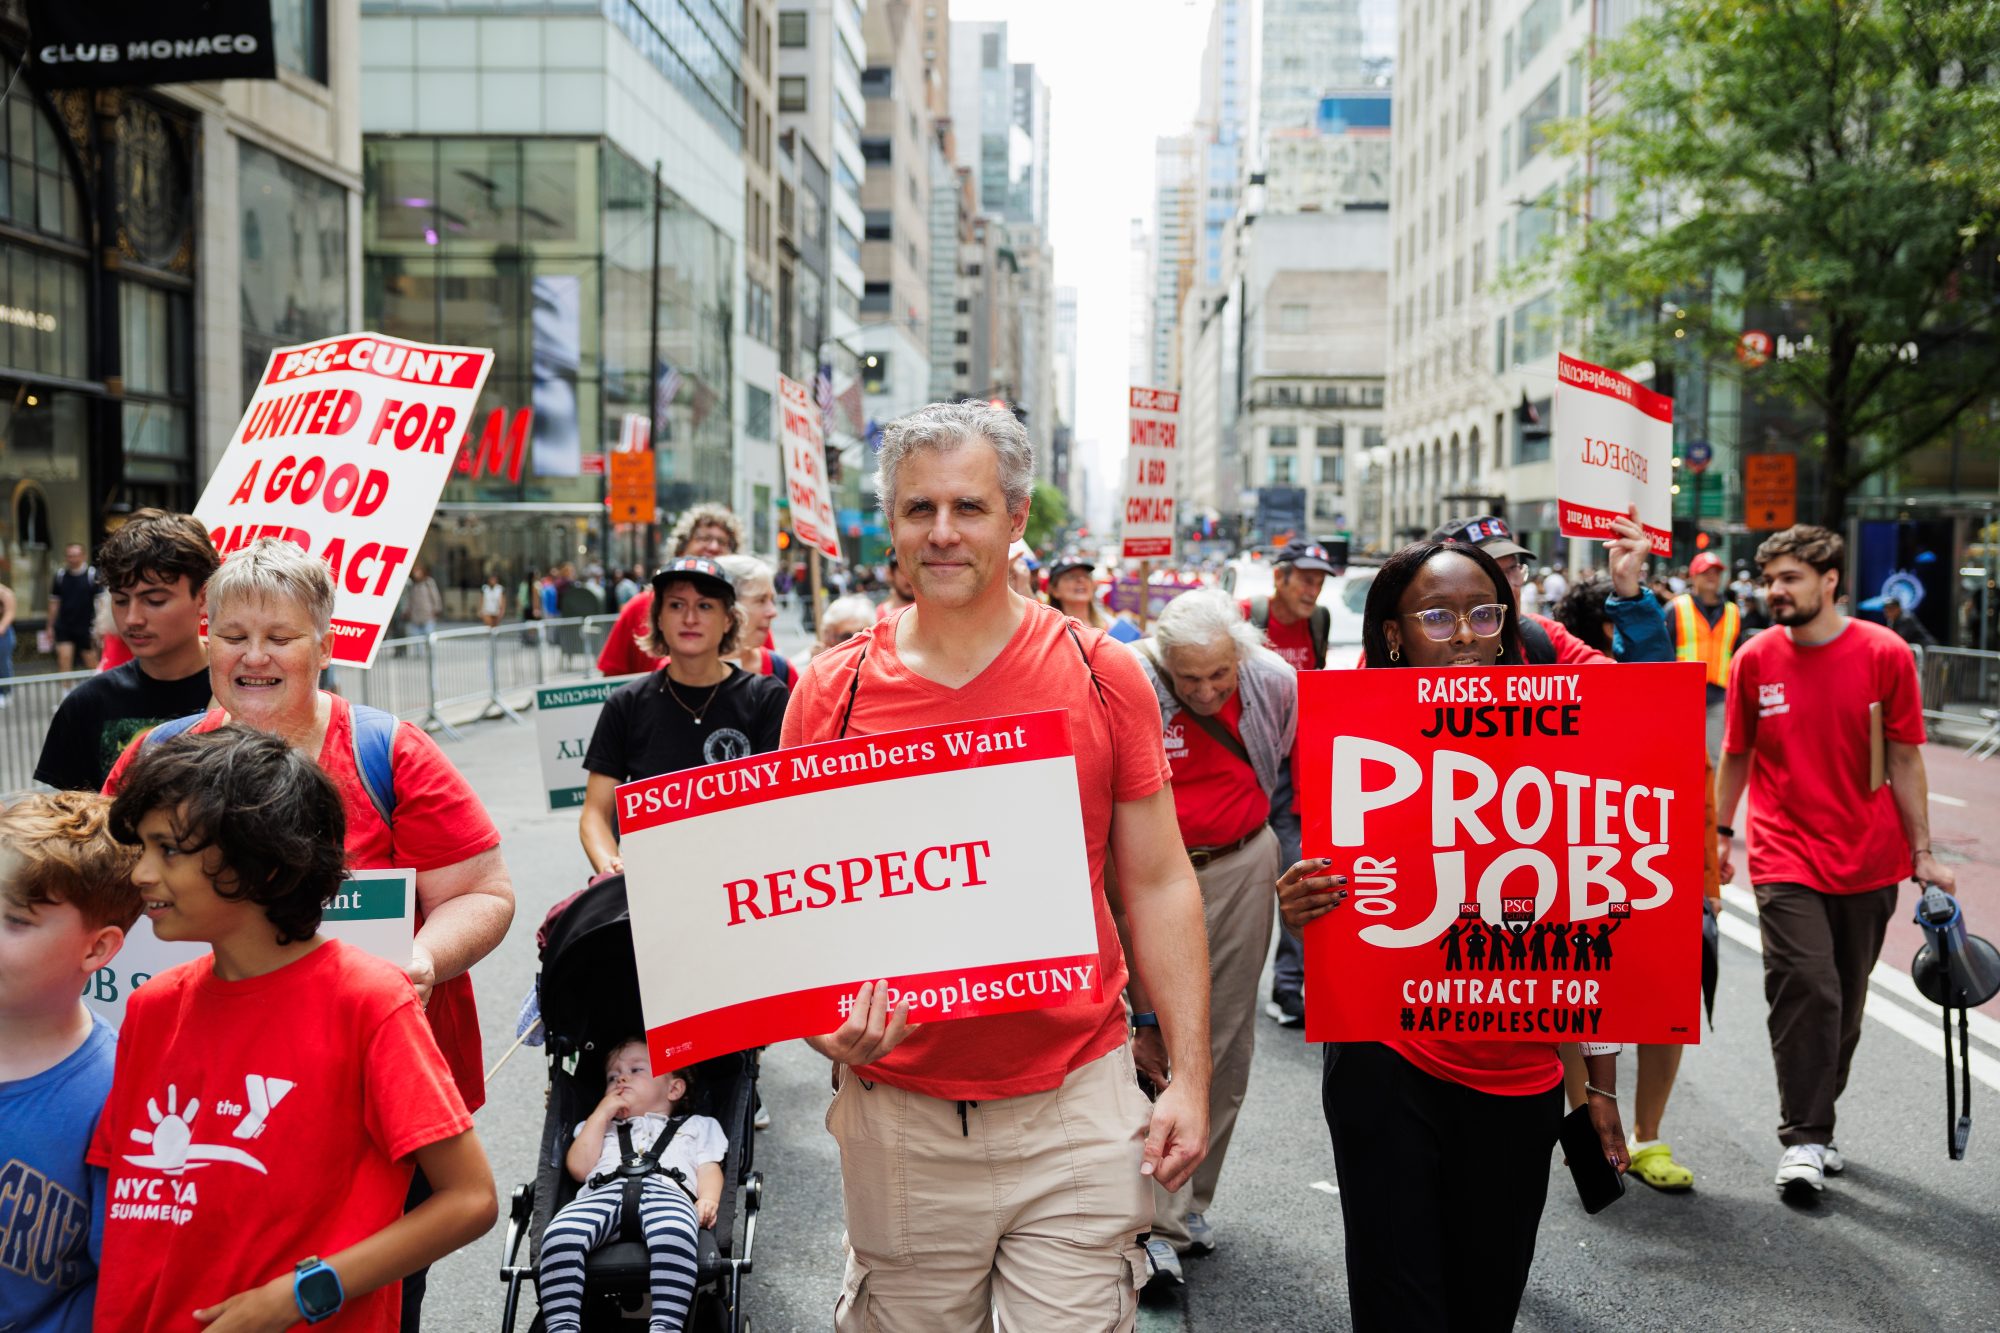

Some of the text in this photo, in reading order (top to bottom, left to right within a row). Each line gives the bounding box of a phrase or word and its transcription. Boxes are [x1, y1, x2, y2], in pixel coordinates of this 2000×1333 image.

[39, 34, 259, 64] CLUB MONACO
[276, 340, 468, 384] PSC-CUNY
[1559, 360, 1633, 399] #APeoplesCUNY
[241, 389, 456, 454] UNITED FOR
[1581, 437, 1649, 484] RESPECT
[229, 455, 389, 517] A GOOD
[1126, 497, 1173, 523] CONTACT
[1566, 509, 1593, 529] Want
[544, 684, 613, 706] plesCUNY
[1418, 674, 1582, 704] RAISES, EQUITY,
[1421, 704, 1581, 738] JUSTICE
[624, 761, 782, 819] PSC/CUNY
[791, 737, 937, 781] Members
[942, 725, 1028, 757] Want
[1332, 735, 1675, 847] PROTECT
[722, 839, 991, 927] RESPECT
[1353, 856, 1397, 915] OUR
[1360, 845, 1673, 948] JOBS
[1460, 903, 1479, 913] PSC
[1503, 899, 1534, 913] PSC
[1610, 903, 1629, 912] PSC
[838, 965, 1094, 1018] #PeoplesCUNY
[1402, 978, 1600, 1005] CONTRACT FOR
[216, 1100, 242, 1117] the
[114, 1178, 165, 1200] NYC
